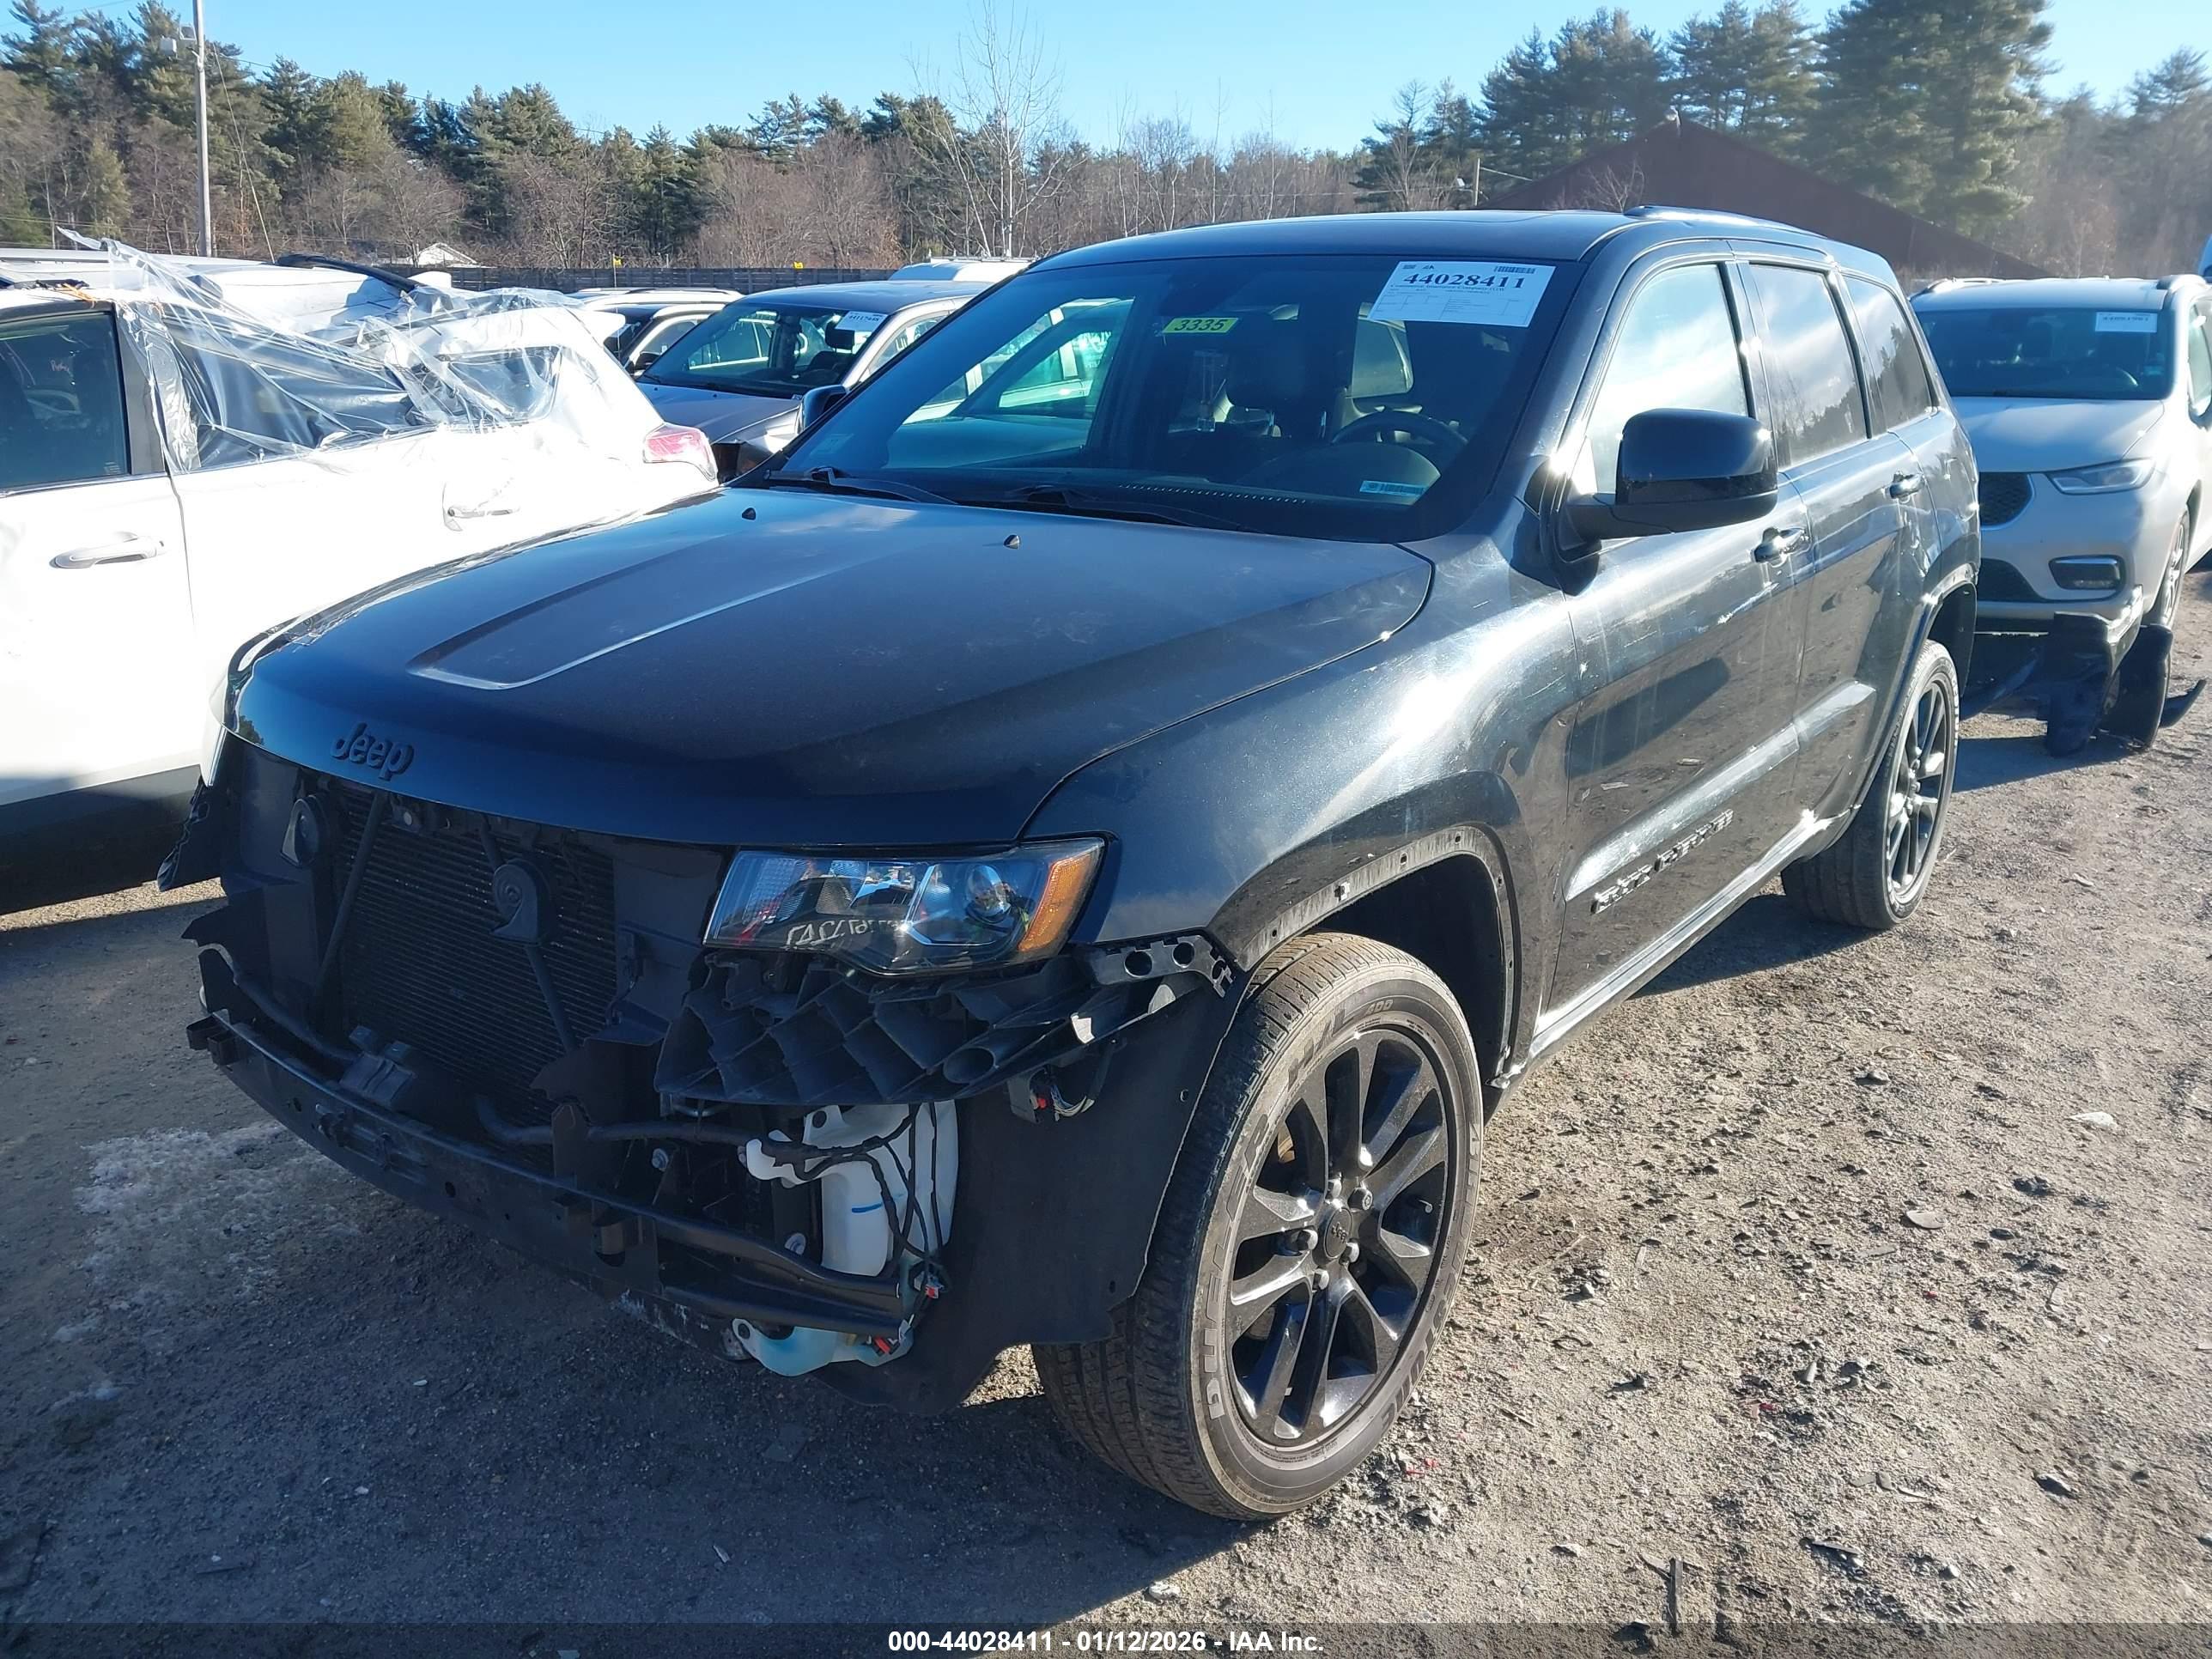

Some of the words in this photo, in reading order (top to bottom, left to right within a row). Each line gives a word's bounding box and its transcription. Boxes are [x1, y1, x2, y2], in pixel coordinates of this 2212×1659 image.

[1404, 273, 1526, 289] 44028411
[1174, 319, 1228, 331] 3335
[330, 721, 415, 781] Jeep
